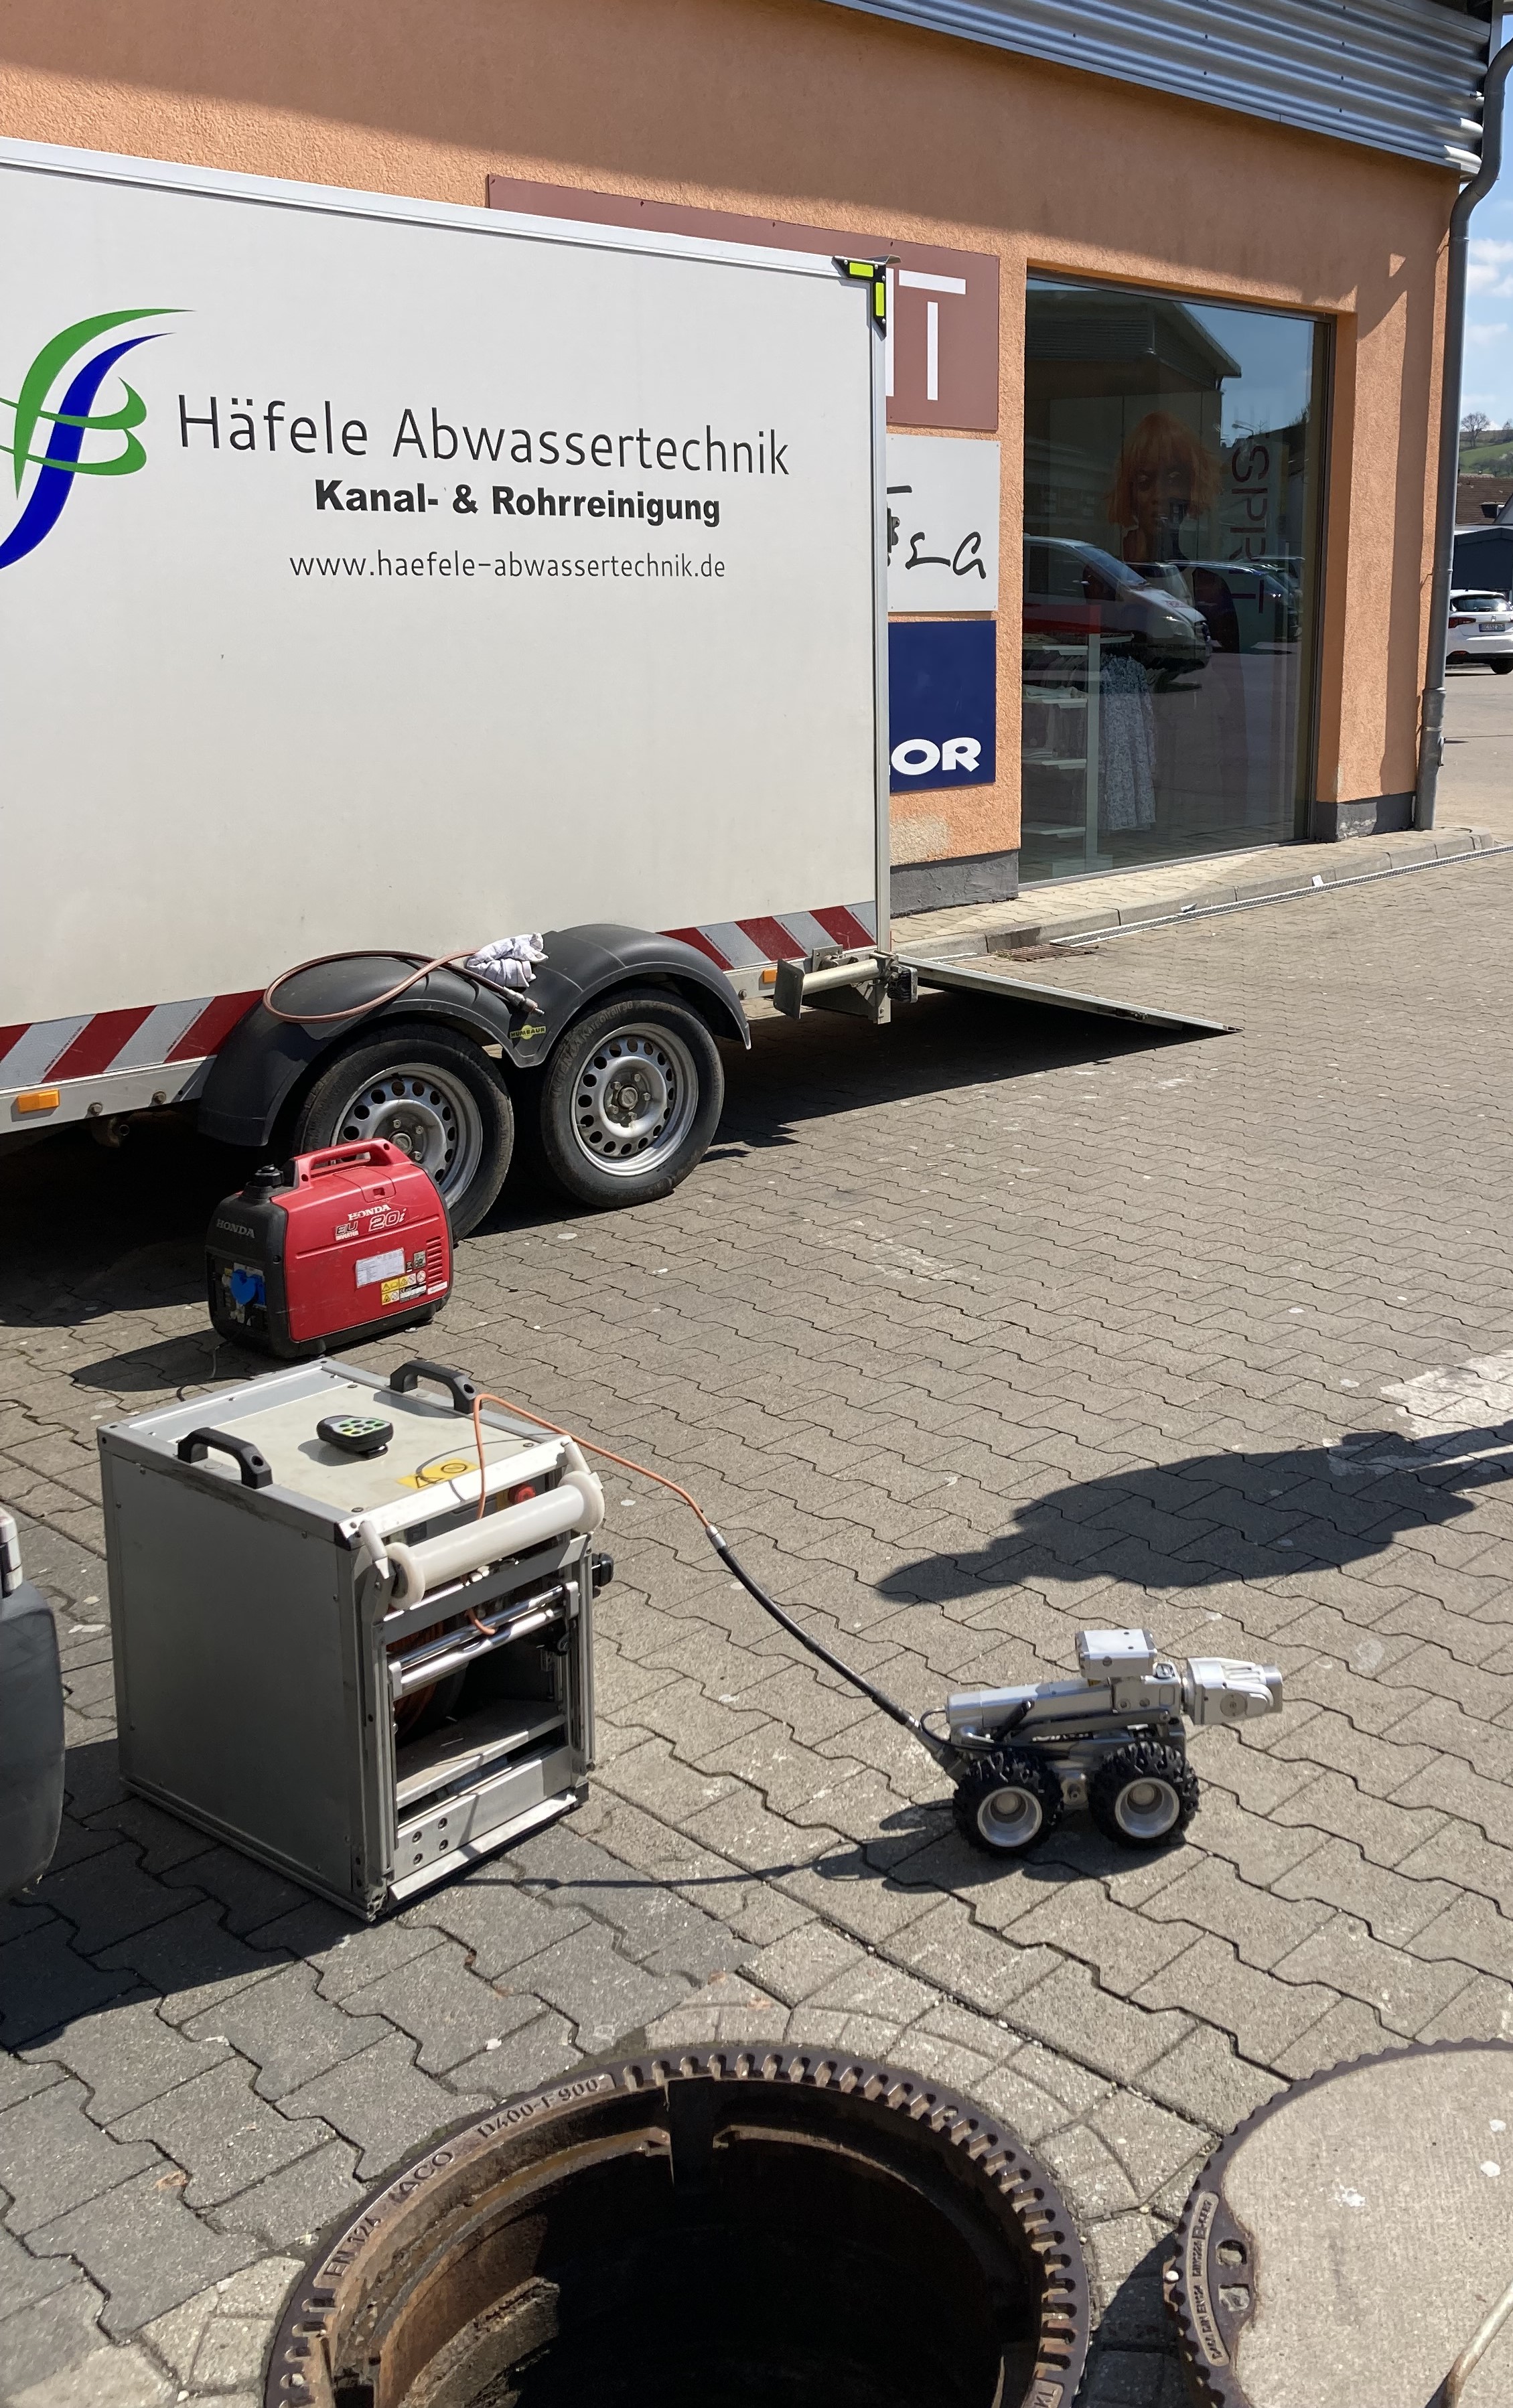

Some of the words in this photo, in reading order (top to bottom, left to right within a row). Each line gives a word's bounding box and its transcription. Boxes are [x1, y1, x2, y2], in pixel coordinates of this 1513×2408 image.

[178, 394, 368, 456] Häfele
[392, 406, 790, 475] Abwassertechnik
[315, 479, 439, 513] Kanal-
[452, 484, 479, 514] &
[492, 485, 720, 528] Rohrreinigung
[1228, 434, 1270, 613] SPRIT
[289, 549, 725, 577] www.haefele-abwassertechnik.de
[889, 737, 981, 777] OR
[510, 1027, 545, 1037] HUMBAUR
[216, 1218, 255, 1239] HONDA
[336, 1221, 358, 1236] EU
[368, 1208, 407, 1231] 20i
[348, 1204, 391, 1221] HONDA
[323, 2250, 356, 2277] EN
[347, 2216, 382, 2243] 124
[399, 2152, 454, 2196] ACO
